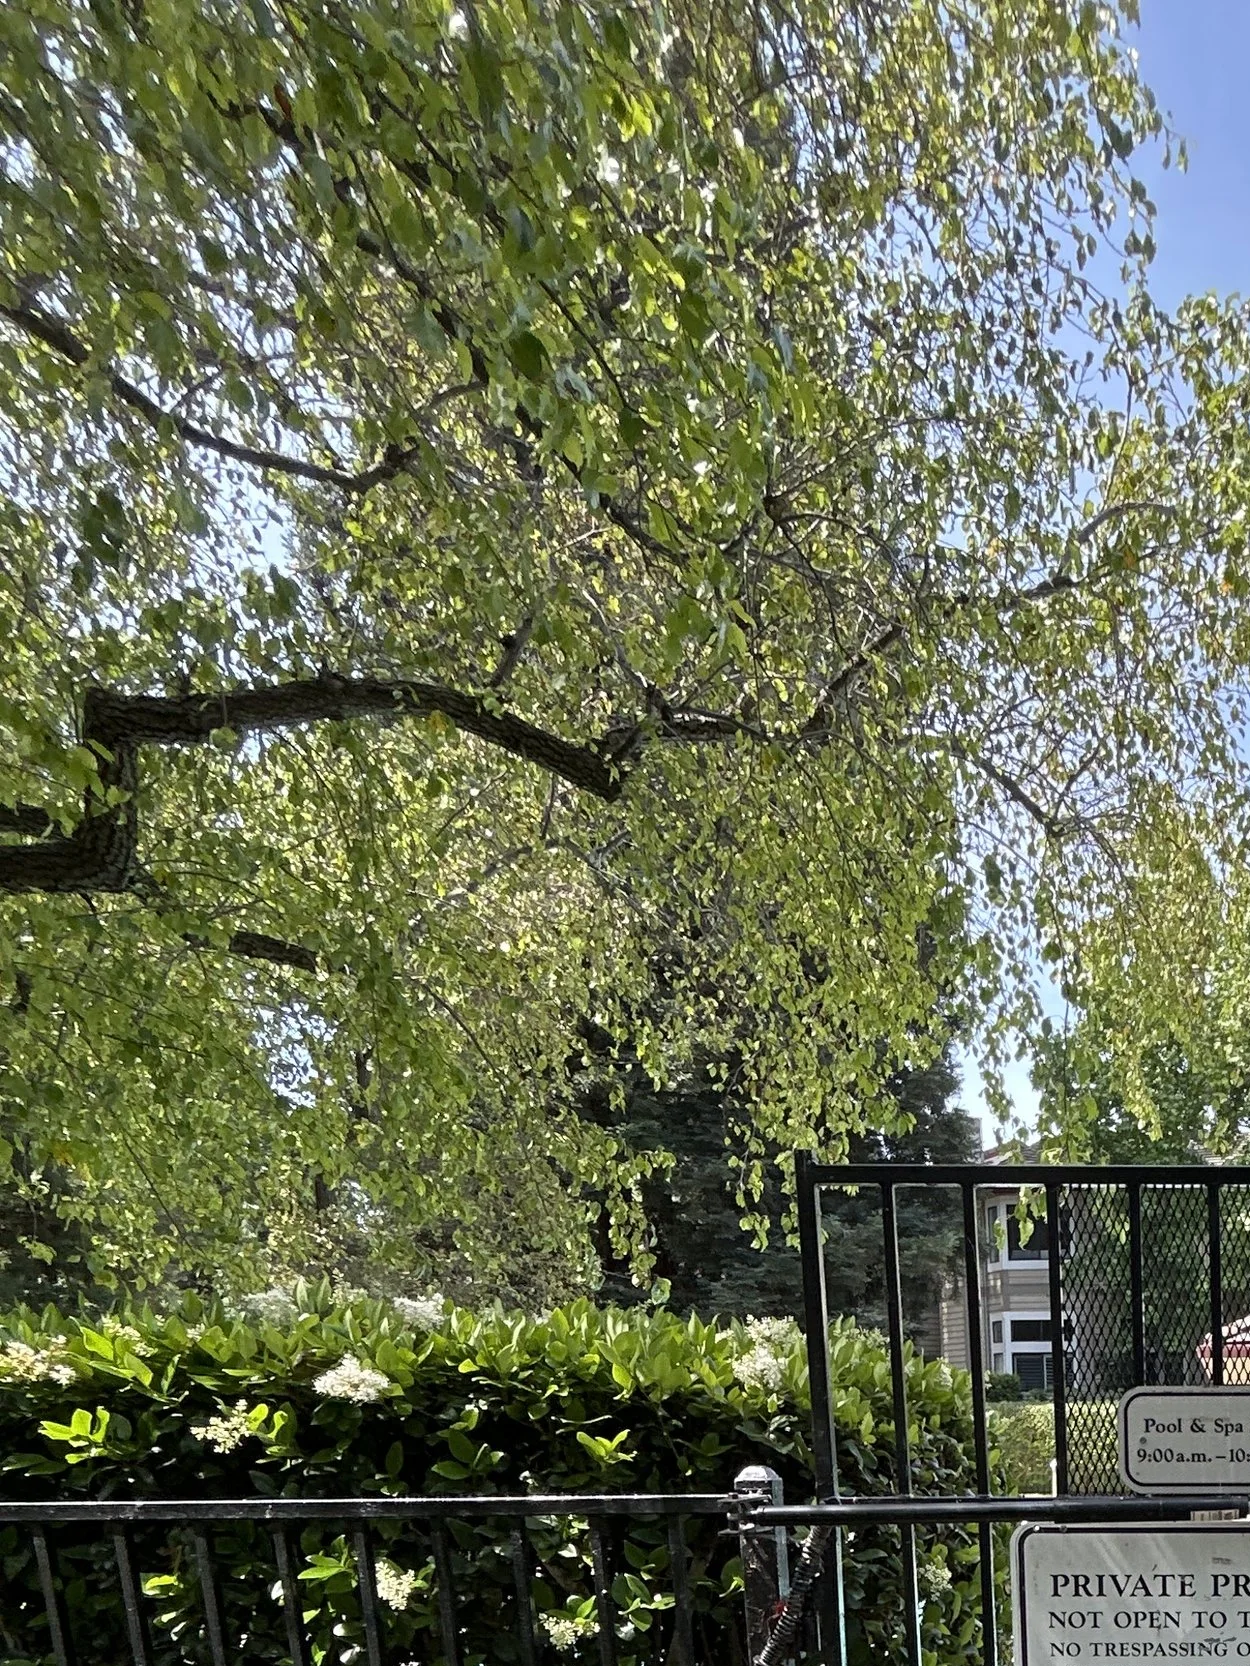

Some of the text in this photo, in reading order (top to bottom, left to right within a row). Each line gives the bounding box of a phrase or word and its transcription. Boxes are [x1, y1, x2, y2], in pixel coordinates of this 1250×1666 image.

[1144, 1418, 1183, 1433] Pool
[1190, 1418, 1206, 1433] &
[1214, 1418, 1244, 1436] Spa
[1050, 1574, 1196, 1597] PRIVATE
[1049, 1611, 1103, 1628] NOT
[1114, 1611, 1181, 1628] OPEN
[1192, 1611, 1227, 1628] TO
[1050, 1642, 1081, 1657] NO
[1090, 1642, 1228, 1657] TRESPASSING
